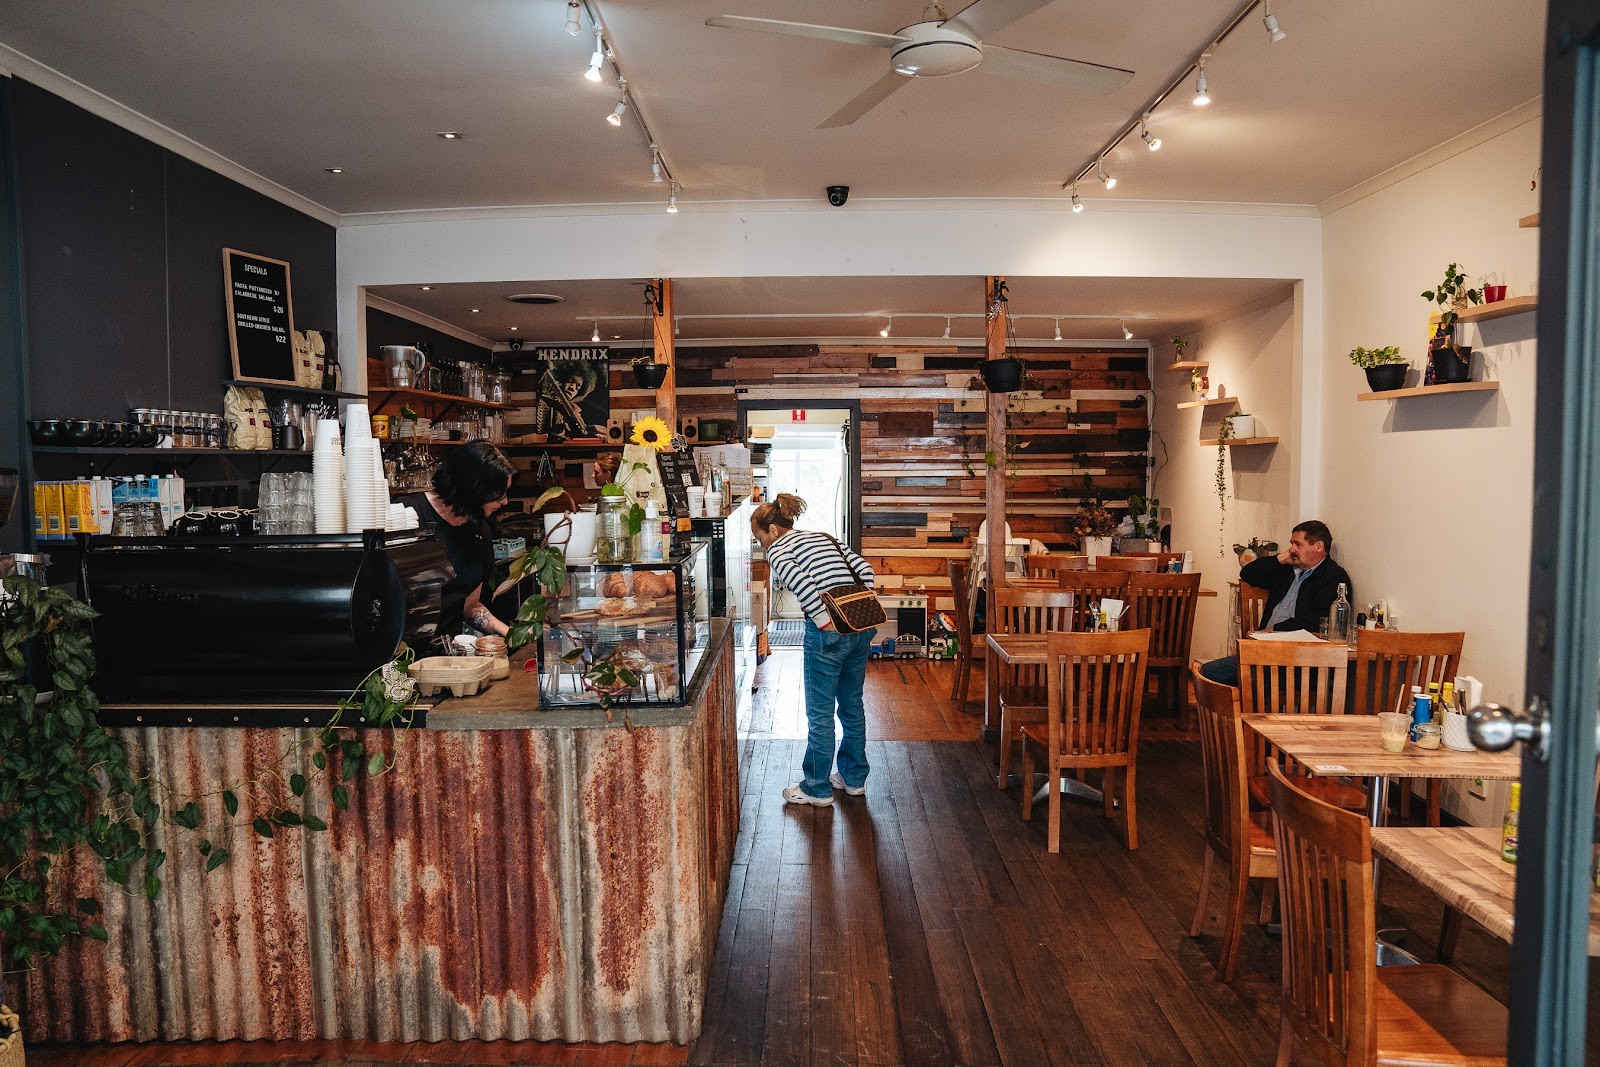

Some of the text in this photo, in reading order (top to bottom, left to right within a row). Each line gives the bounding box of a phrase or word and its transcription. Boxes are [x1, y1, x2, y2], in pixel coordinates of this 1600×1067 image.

[244, 264, 268, 276] SPECIALS
[237, 313, 258, 322] SOUTHERN
[276, 335, 286, 344] $22
[538, 348, 608, 360] HENDRIX
